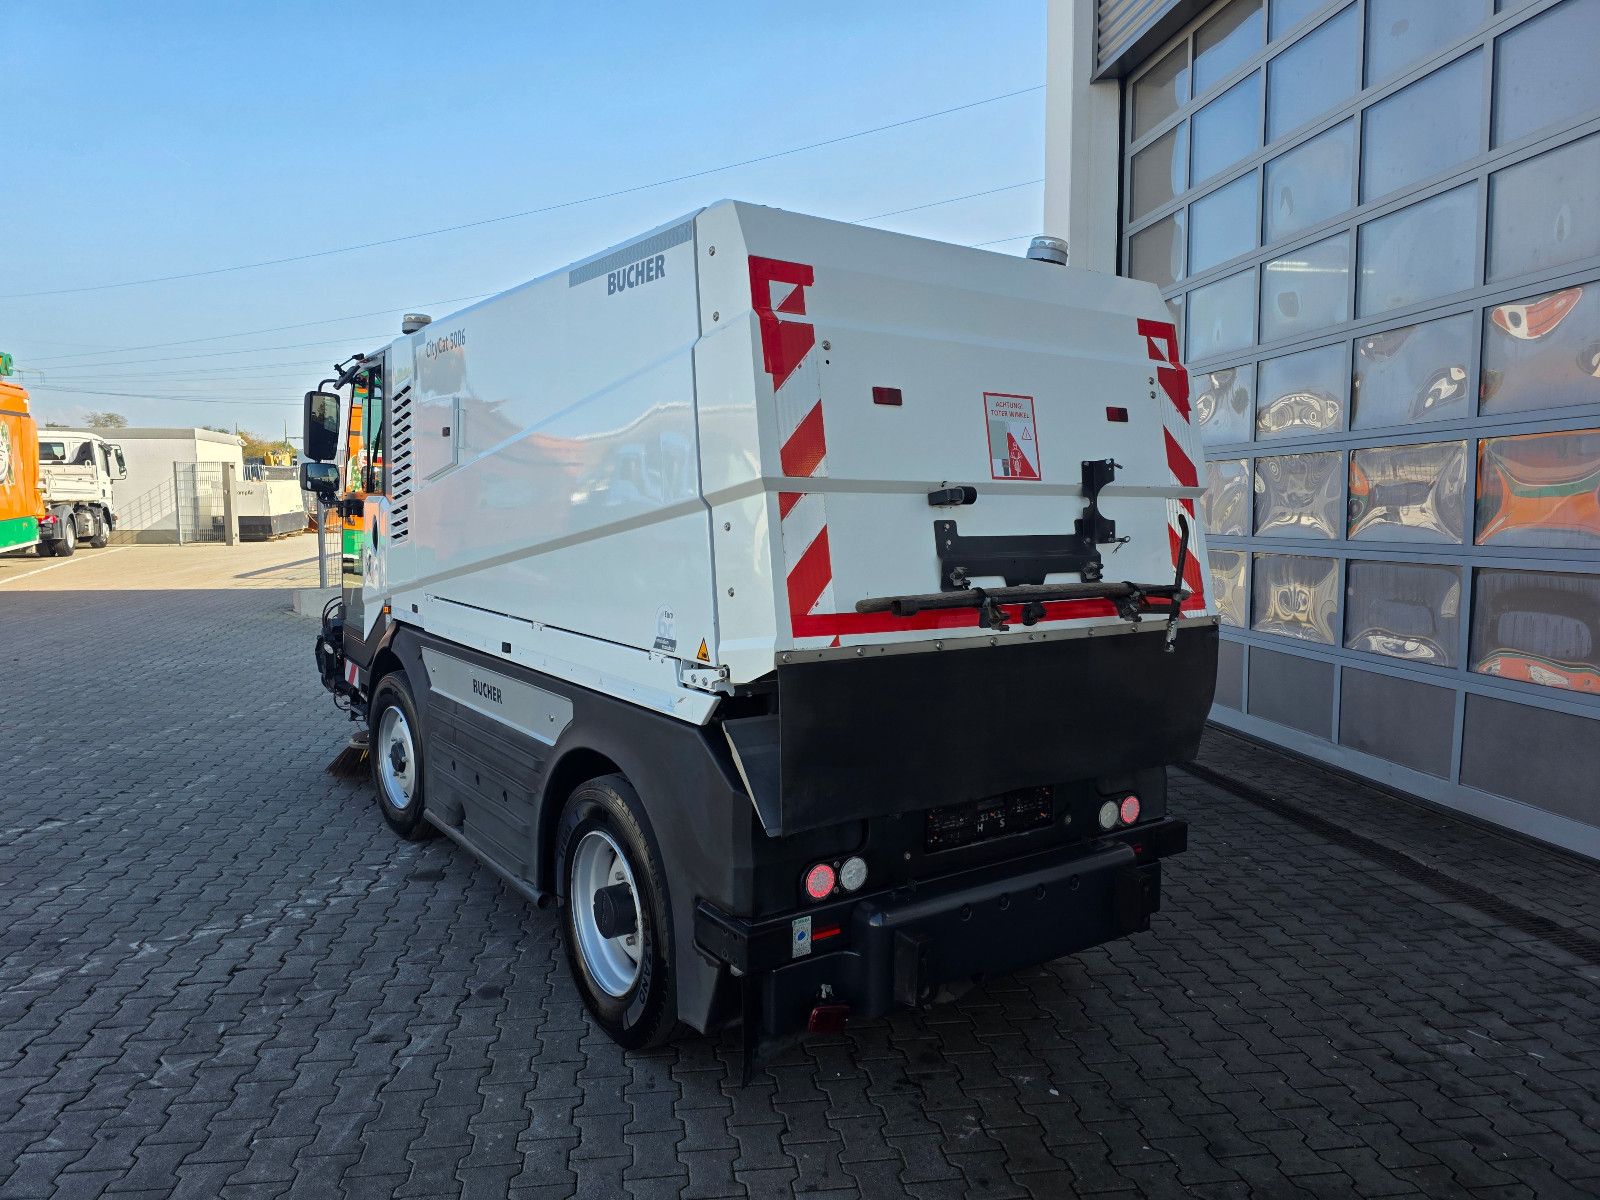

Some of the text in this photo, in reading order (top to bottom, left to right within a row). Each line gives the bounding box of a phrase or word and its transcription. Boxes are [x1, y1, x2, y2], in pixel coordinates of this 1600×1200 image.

[607, 254, 666, 296] BUCHER
[426, 328, 466, 360] CityCat 5006
[990, 409, 1030, 419] TOTER WINKEL
[472, 678, 503, 705] BUCHER
